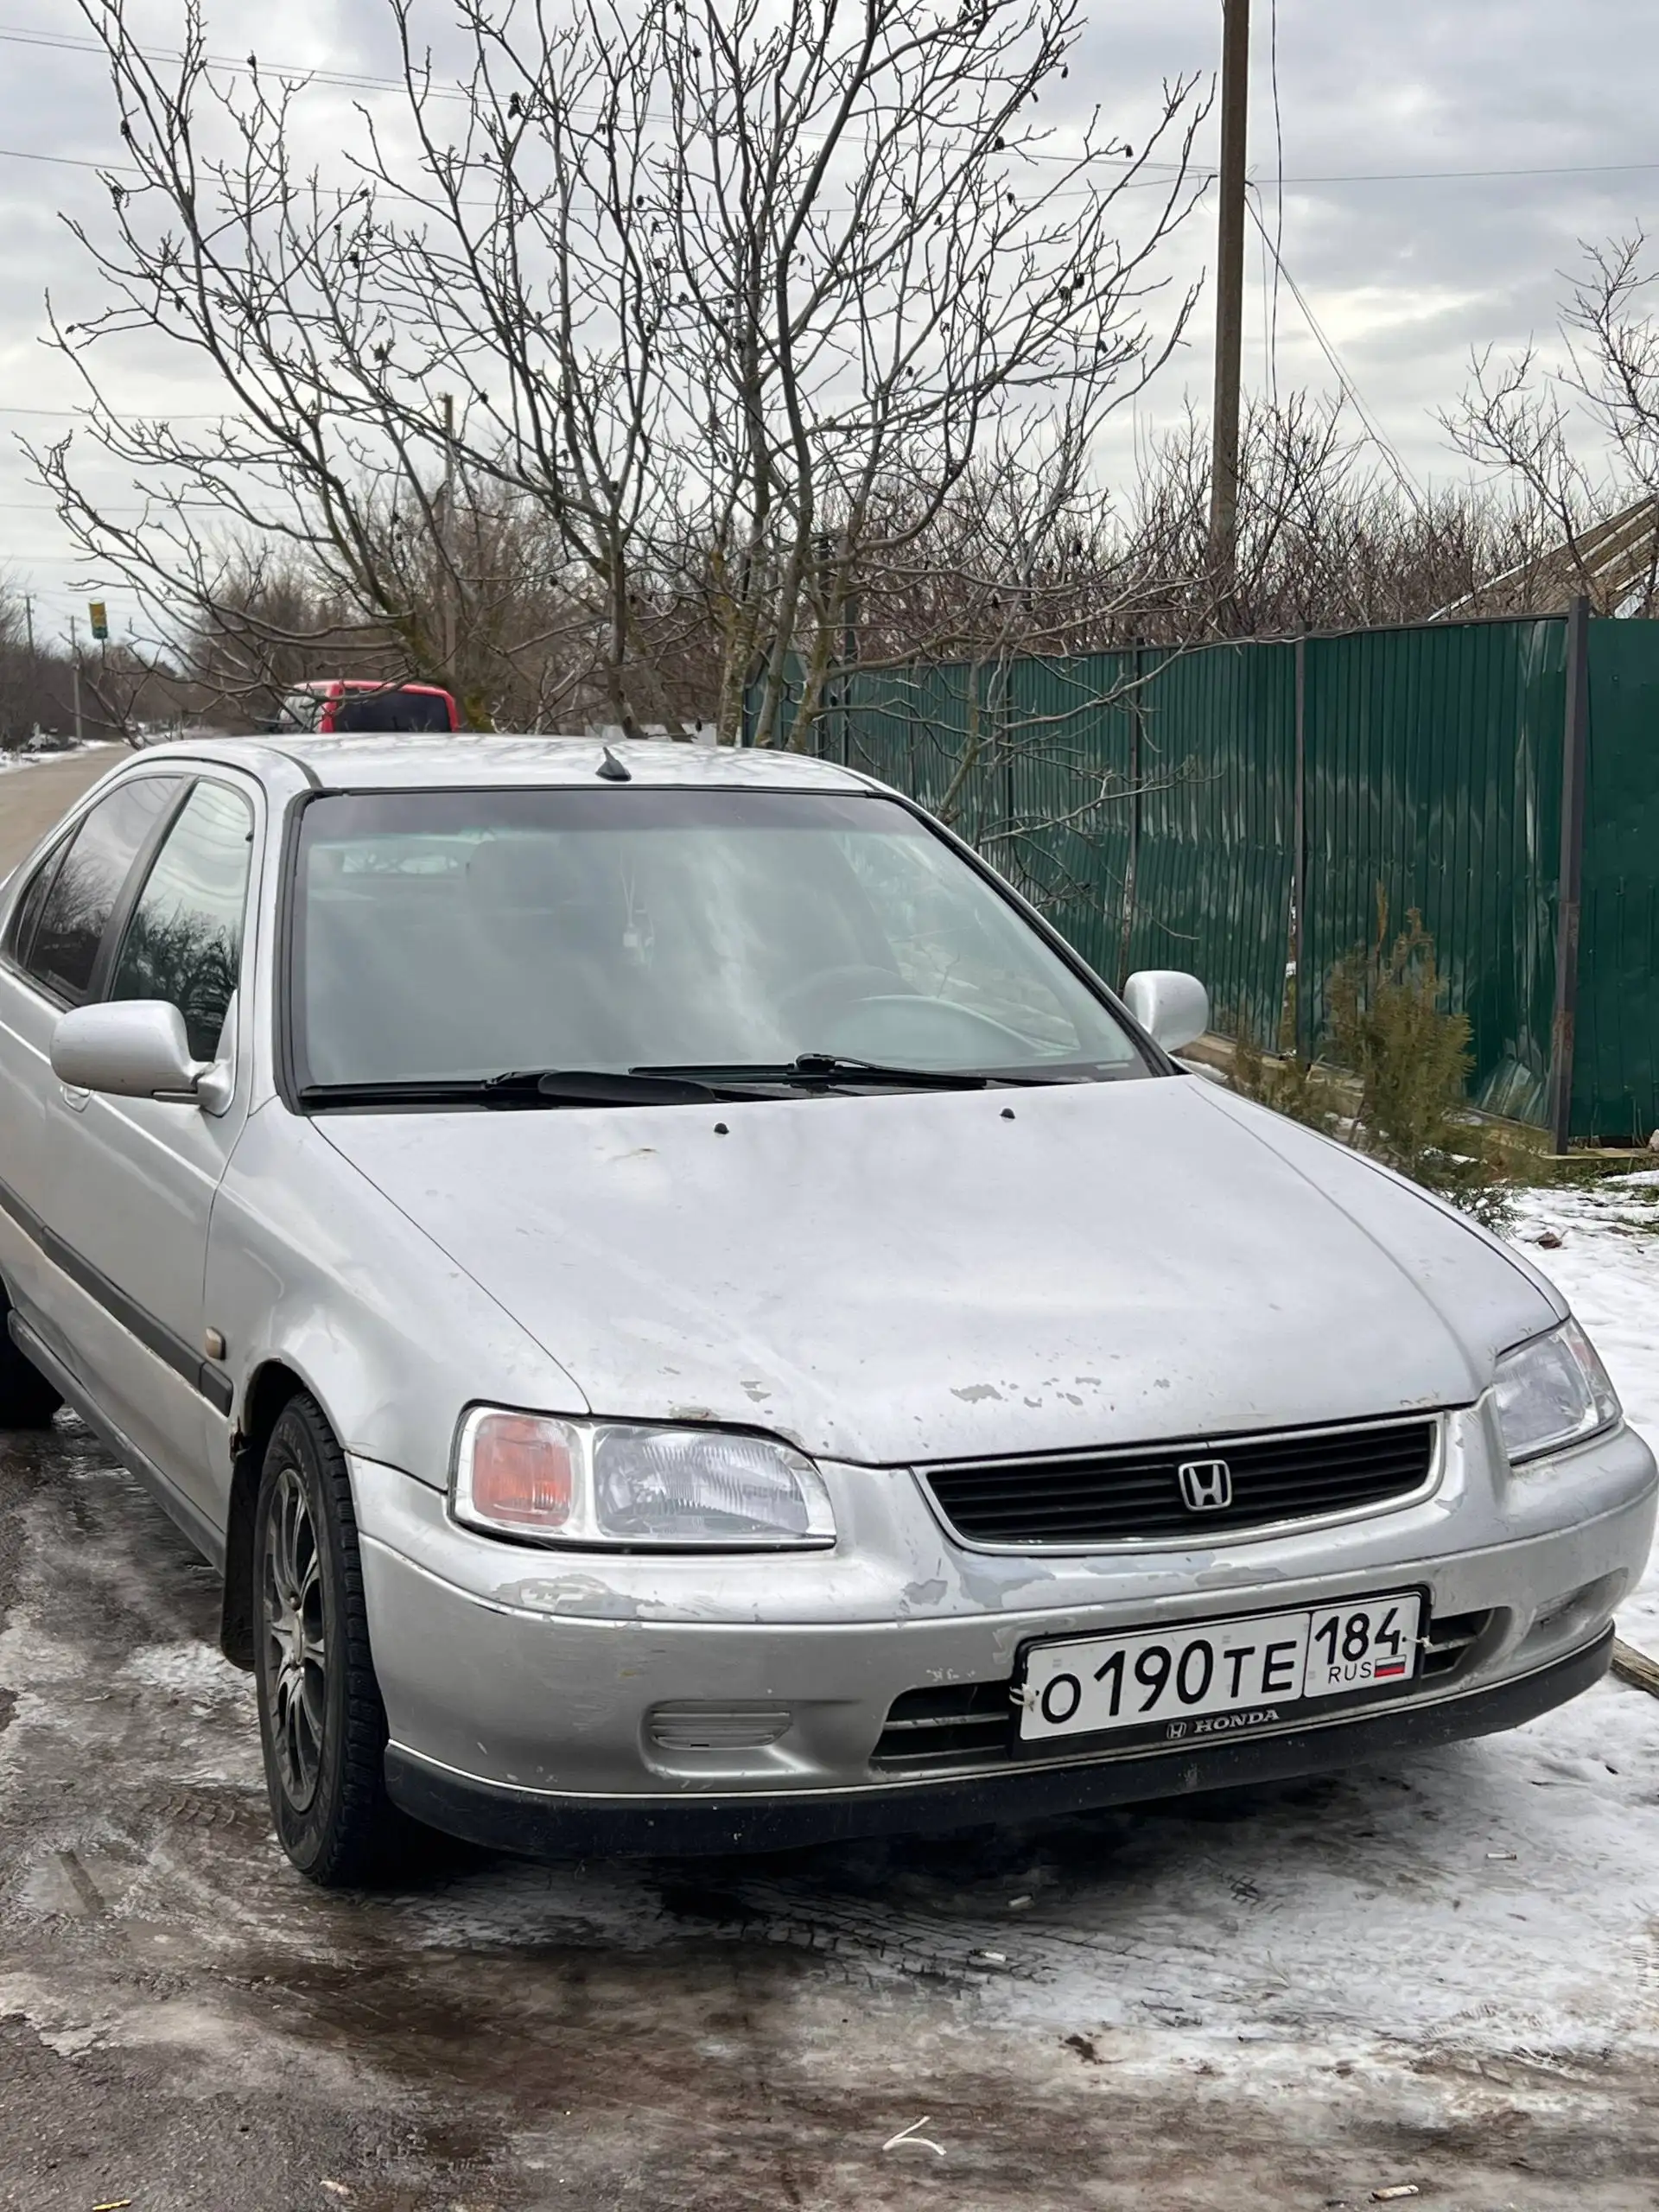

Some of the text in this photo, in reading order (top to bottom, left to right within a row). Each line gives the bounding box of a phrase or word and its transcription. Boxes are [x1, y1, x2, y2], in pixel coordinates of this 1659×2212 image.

[1314, 1607, 1401, 1665] 184
[1328, 1662, 1371, 1684] RUS
[1194, 1709, 1280, 1733] HONDA
